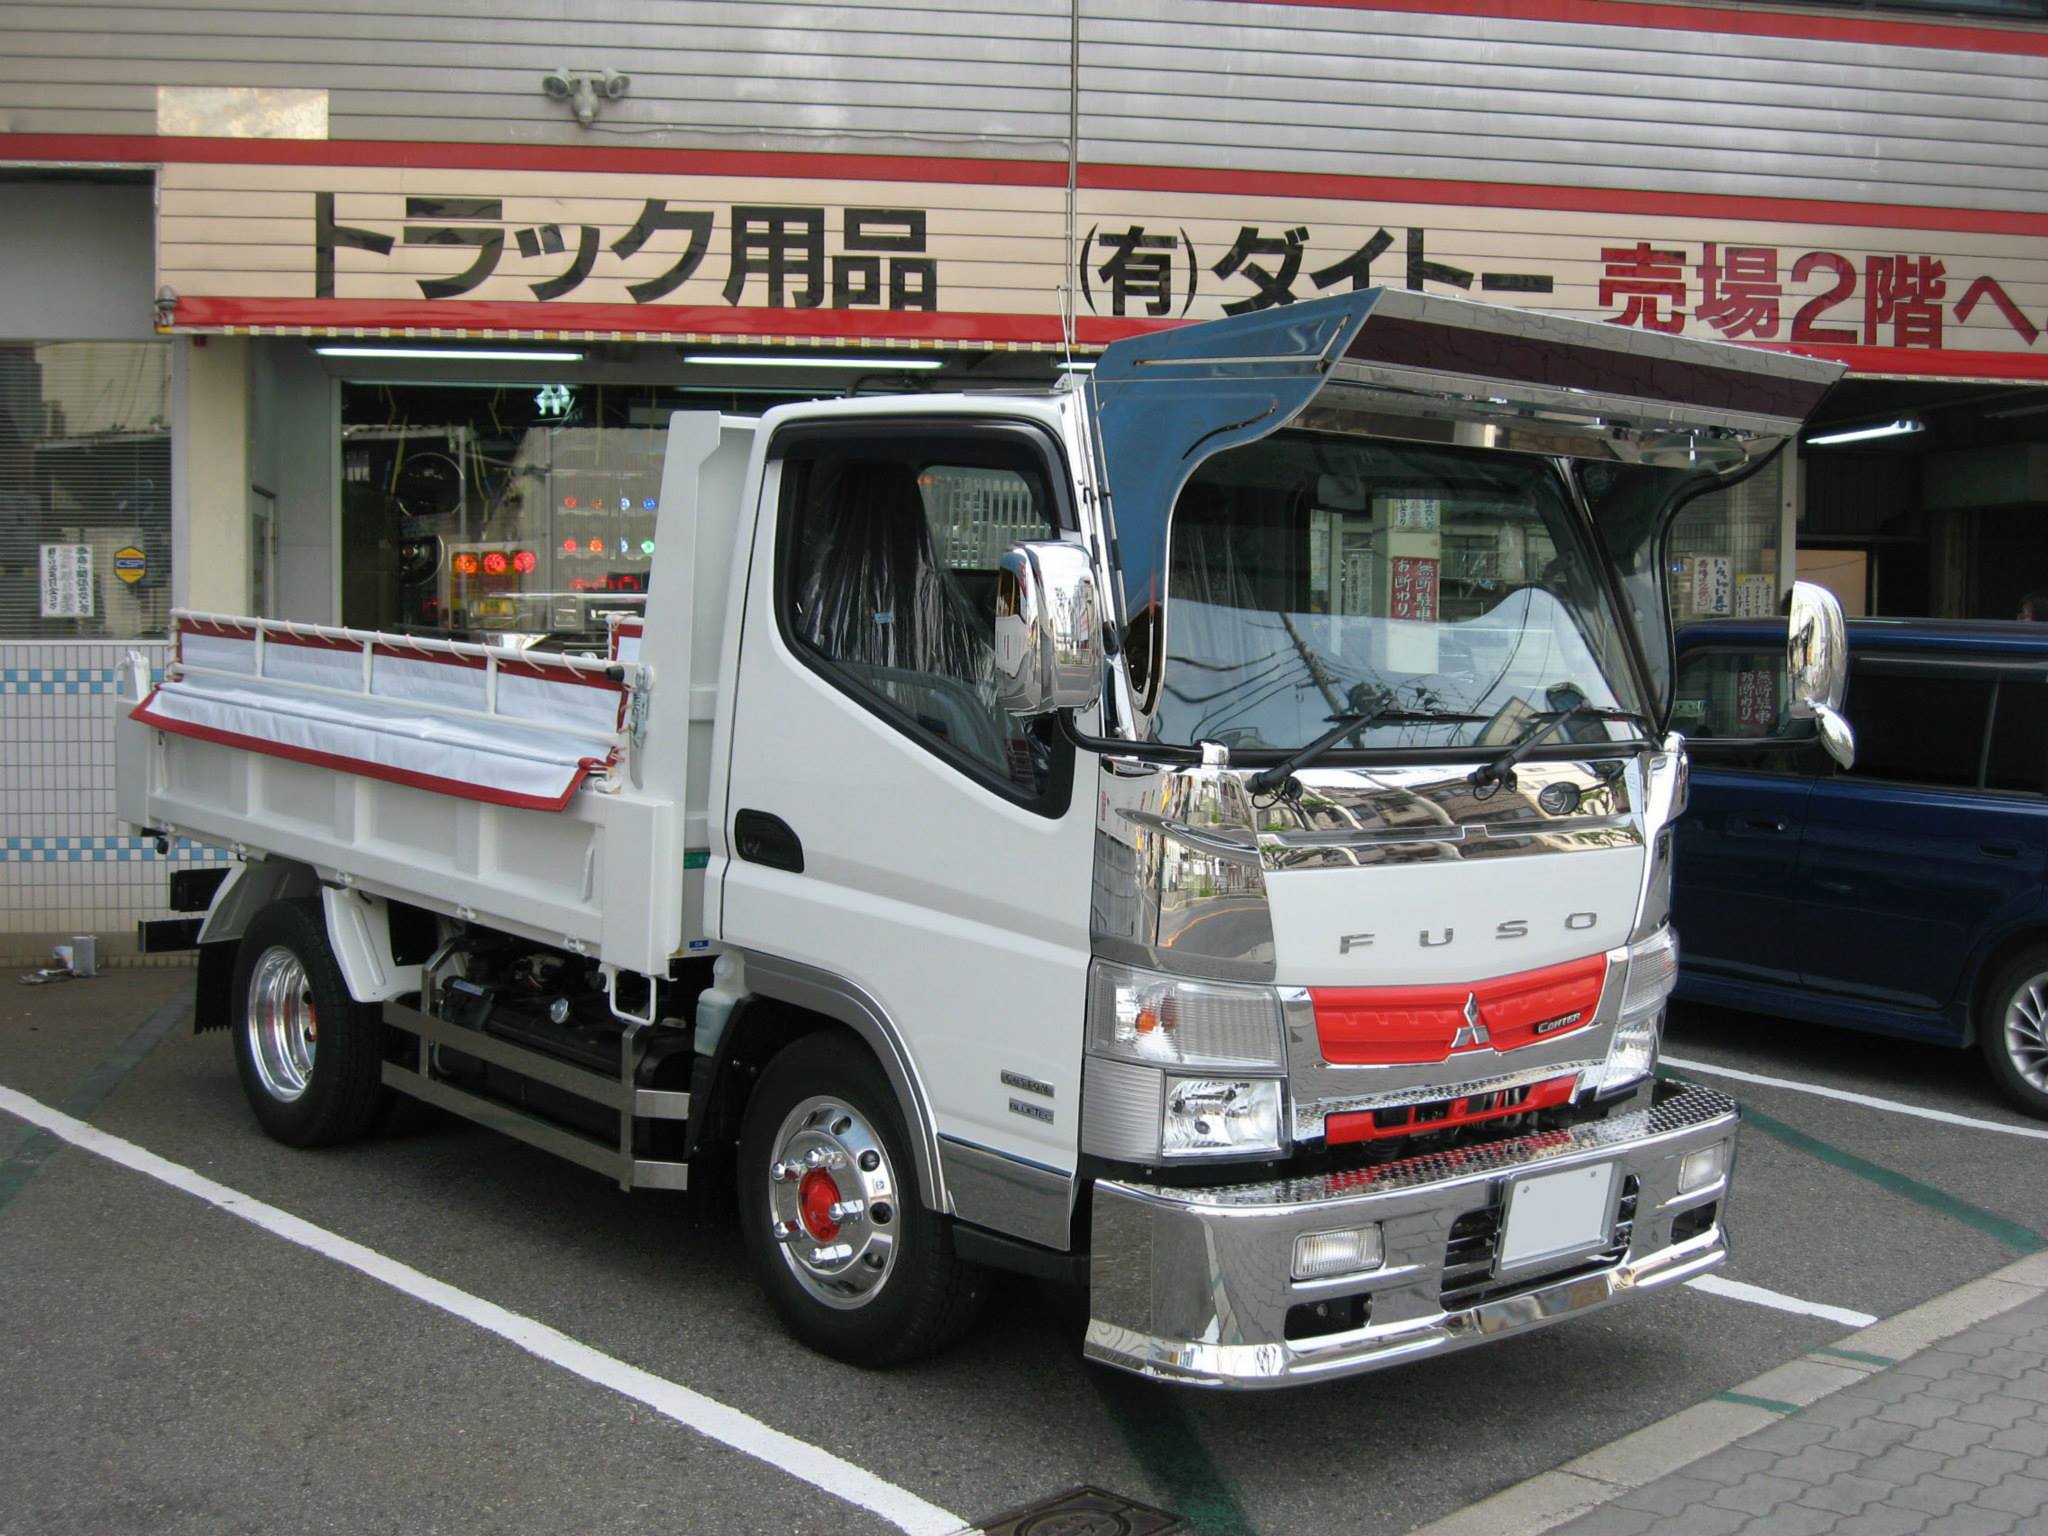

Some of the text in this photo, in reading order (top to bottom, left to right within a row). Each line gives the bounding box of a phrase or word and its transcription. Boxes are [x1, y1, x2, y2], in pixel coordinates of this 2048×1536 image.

[315, 191, 937, 312] トラック用品
[1598, 242, 2040, 350] 売場2階へ
[1339, 912, 1598, 954] FUSO
